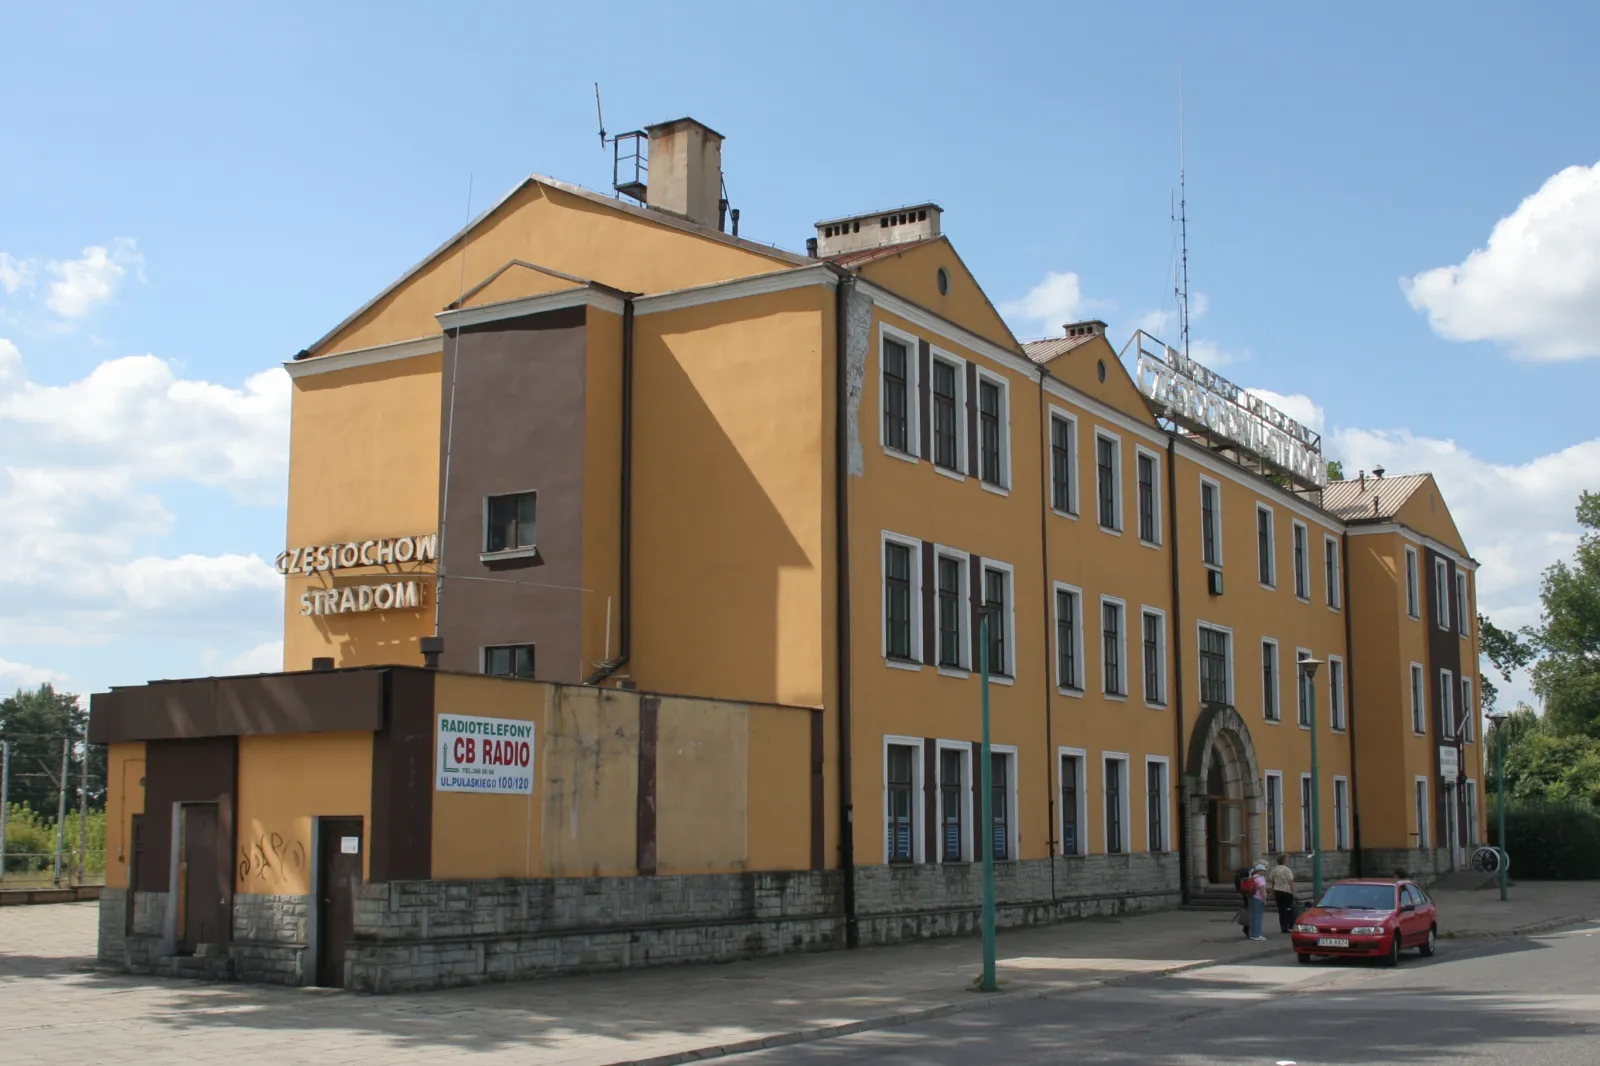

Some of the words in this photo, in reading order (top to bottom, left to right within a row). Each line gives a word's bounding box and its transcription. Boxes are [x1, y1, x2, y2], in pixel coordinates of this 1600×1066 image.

[300, 580, 419, 616] STRADOM
[441, 719, 532, 737] RADIOTELEFONY
[453, 737, 476, 764] CB
[482, 739, 530, 767] RADIO
[498, 776, 529, 790] 100/120
